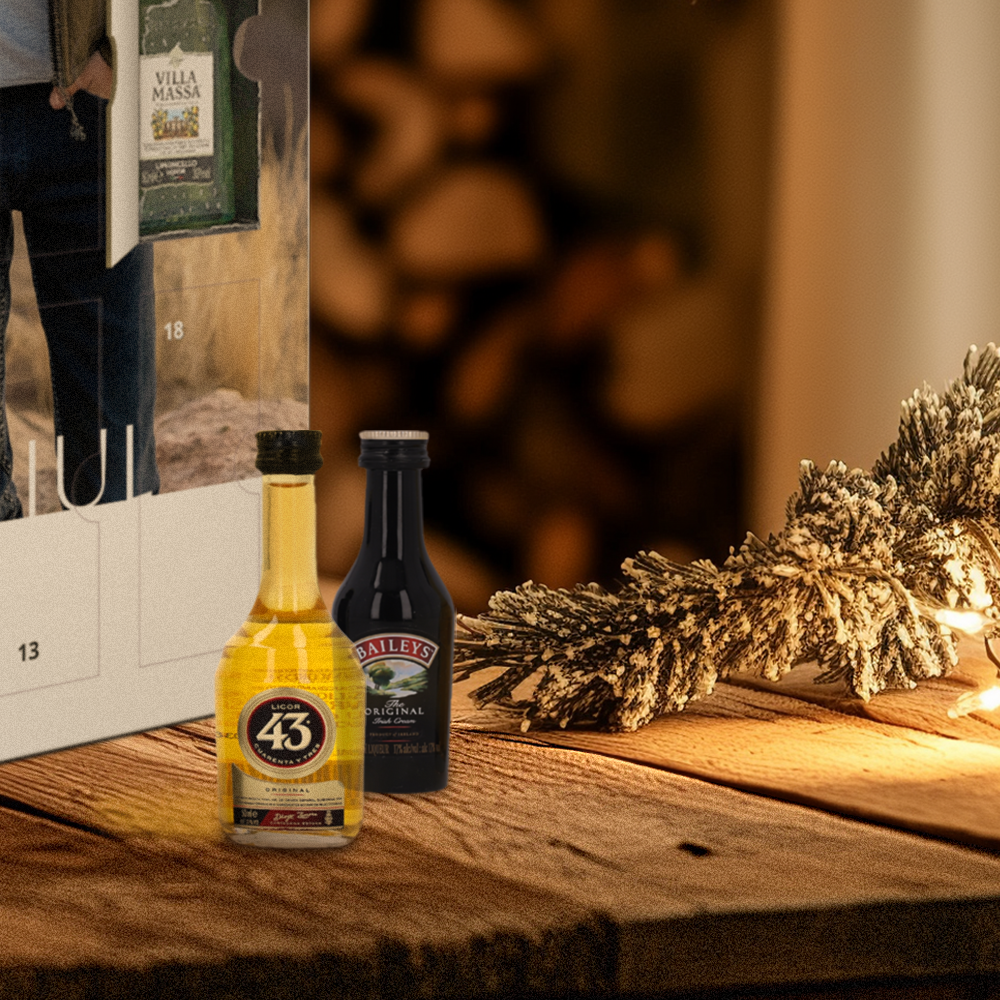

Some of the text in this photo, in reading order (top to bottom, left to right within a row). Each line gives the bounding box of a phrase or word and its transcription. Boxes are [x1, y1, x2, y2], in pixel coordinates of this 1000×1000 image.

[156, 70, 197, 85] VILLA
[151, 84, 201, 101] MASSA
[164, 320, 184, 341] 18
[17, 640, 40, 662] 13
[356, 638, 431, 660] BAILEYS
[271, 703, 301, 711] LICOR
[364, 707, 424, 716] ORIGINAL
[384, 700, 406, 709] The
[255, 712, 312, 751] 43
[254, 742, 294, 765] CUARENTA
[303, 742, 321, 760] TRES
